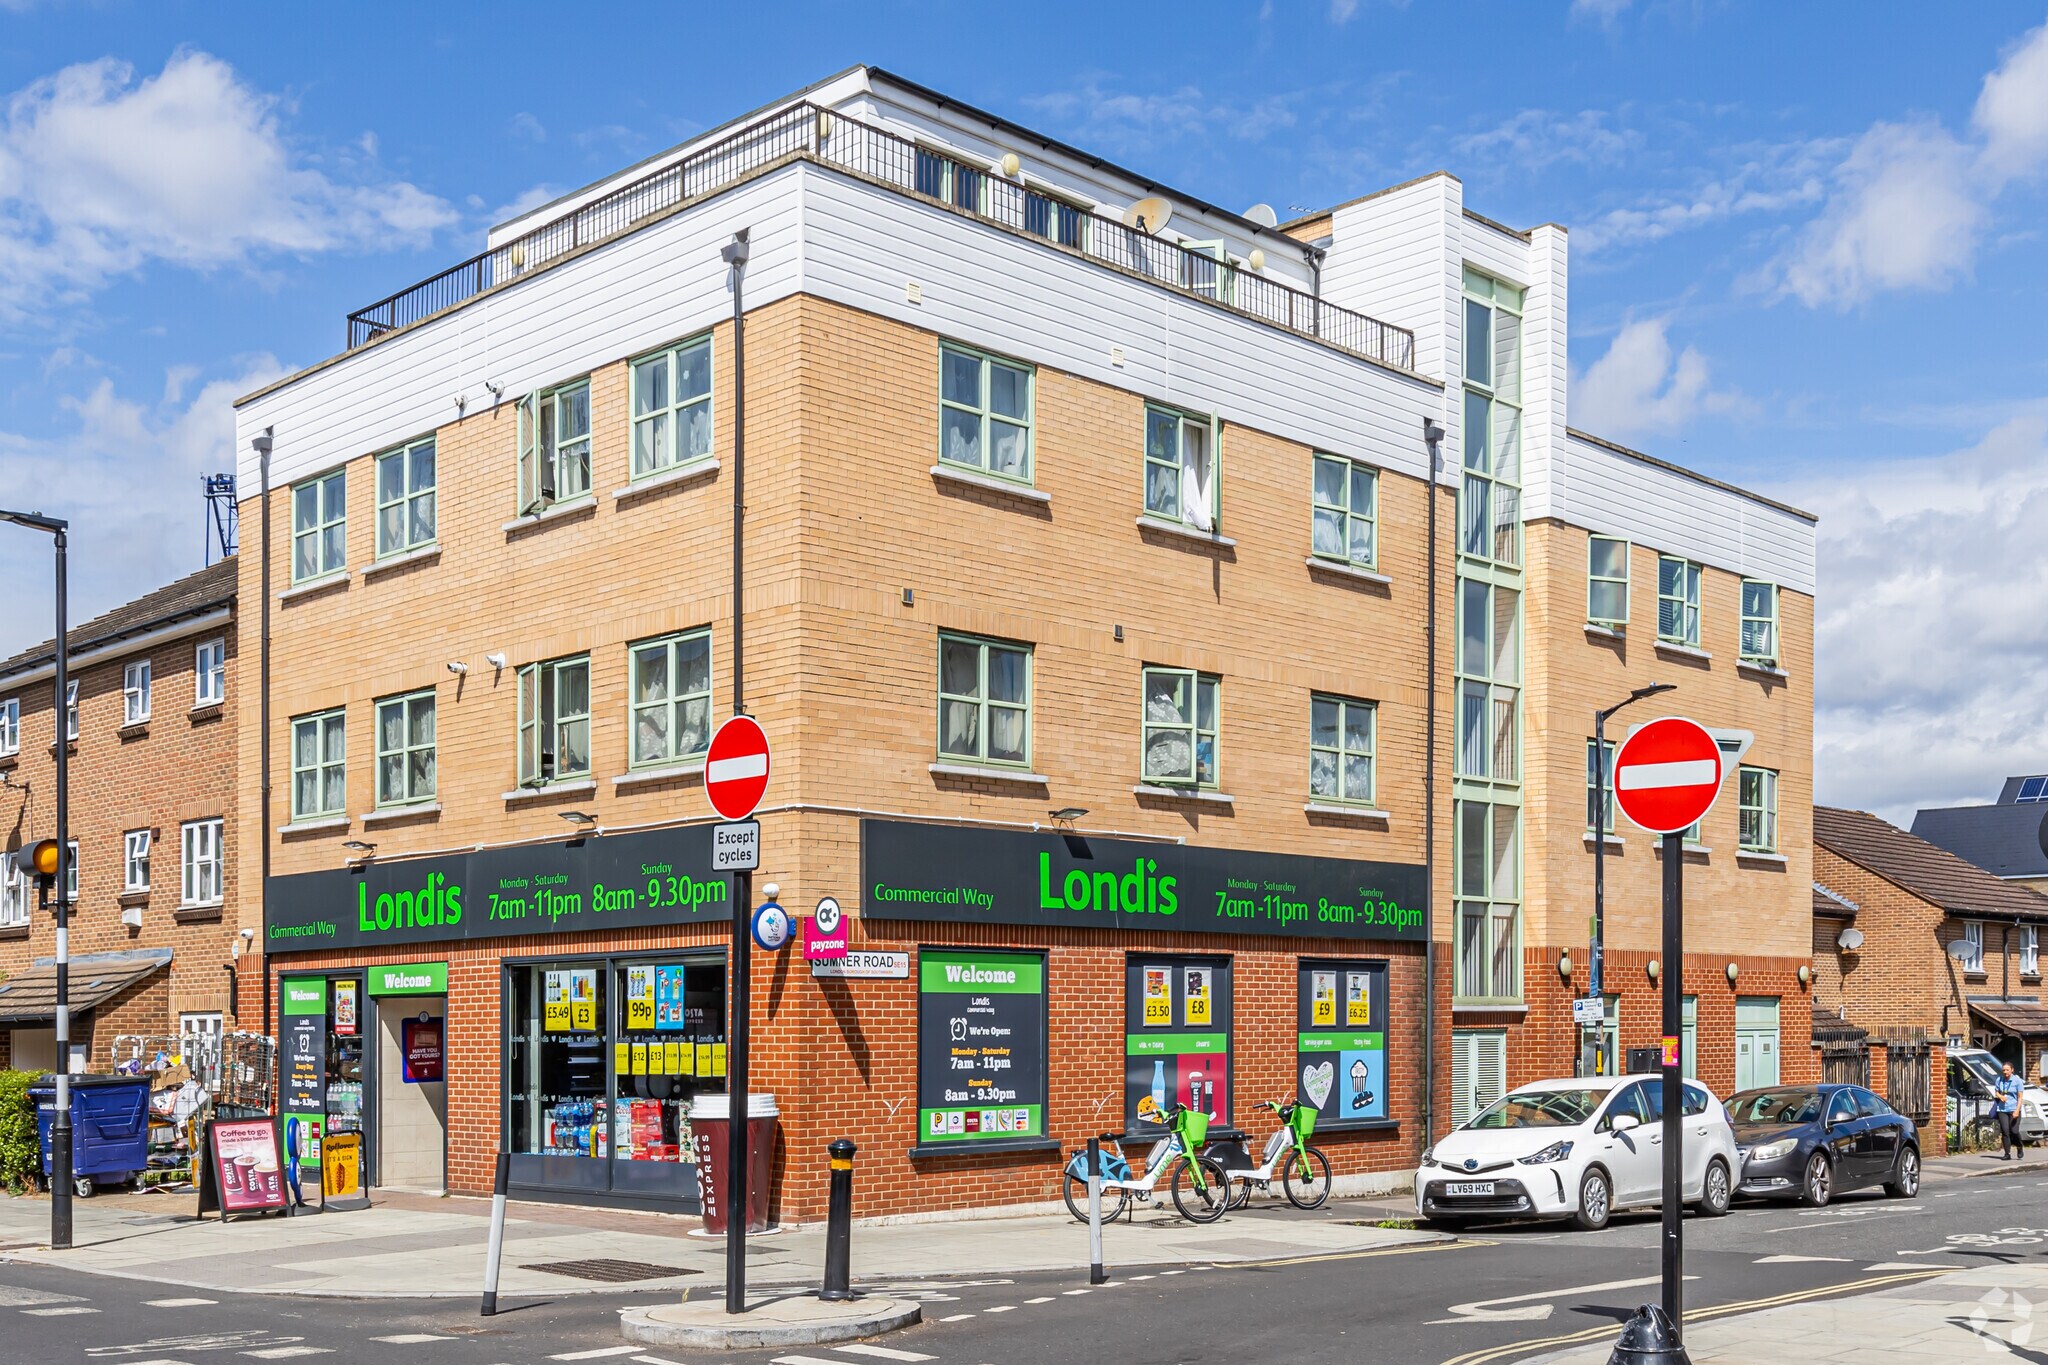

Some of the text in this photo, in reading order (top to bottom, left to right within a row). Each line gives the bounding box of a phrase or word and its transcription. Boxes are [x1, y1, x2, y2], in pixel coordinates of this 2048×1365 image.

[718, 829, 755, 845] Except
[718, 848, 752, 864] cycles
[641, 862, 673, 876] Sunday
[499, 877, 529, 890] Monday
[534, 873, 569, 887] Saturday
[1039, 851, 1179, 916] Londis
[1227, 878, 1258, 892] Monday
[1263, 880, 1297, 894] Saturday
[874, 882, 994, 911] Commercial Way
[1358, 886, 1384, 900] Sunday
[359, 871, 463, 932] Londis
[269, 919, 337, 939] Commercial Way
[810, 939, 845, 953] payzone
[814, 955, 907, 969] SUMNER ROAD SE15
[384, 972, 432, 989] Welcome
[945, 964, 1016, 984] Welcome
[290, 989, 320, 1001] Welcome
[971, 996, 990, 1006] Londis
[547, 1006, 569, 1019] £5.49
[632, 1001, 652, 1020] 99p
[684, 1008, 704, 1017] OSTA
[1146, 1005, 1170, 1017] £3.50
[1191, 1000, 1205, 1014] £8
[1318, 1002, 1331, 1016] £9
[1349, 1008, 1368, 1019] £6.25
[578, 1008, 590, 1023] £3
[559, 1035, 574, 1043] Londis
[584, 1035, 600, 1043] Londis
[641, 1035, 659, 1043] Londis
[669, 1035, 686, 1043] Londis
[697, 1034, 715, 1043] Londis
[969, 1026, 1011, 1038] We're Open:
[421, 1052, 441, 1060] YOURS?
[633, 1052, 645, 1061] £12
[650, 1051, 662, 1061] £13
[951, 1047, 978, 1058] Monday
[981, 1047, 1011, 1057] Saturday
[950, 1056, 975, 1070] 7am
[983, 1056, 1012, 1072] 11pm
[291, 1079, 302, 1088] 7am
[304, 1079, 318, 1090] 11pm
[968, 1078, 993, 1089] Sunday
[558, 1095, 574, 1103] Londis
[944, 1088, 969, 1102] 8am
[977, 1087, 1016, 1103] 9.30pm
[220, 1129, 269, 1138] Coffee to go,
[325, 1142, 355, 1152] Rollover
[701, 1134, 716, 1205] EXPRESS
[1153, 1153, 1173, 1179] Lime
[223, 1163, 233, 1185] COSTA
[247, 1168, 256, 1191] COSTA
[1452, 1184, 1492, 1194] LV69 HXC
